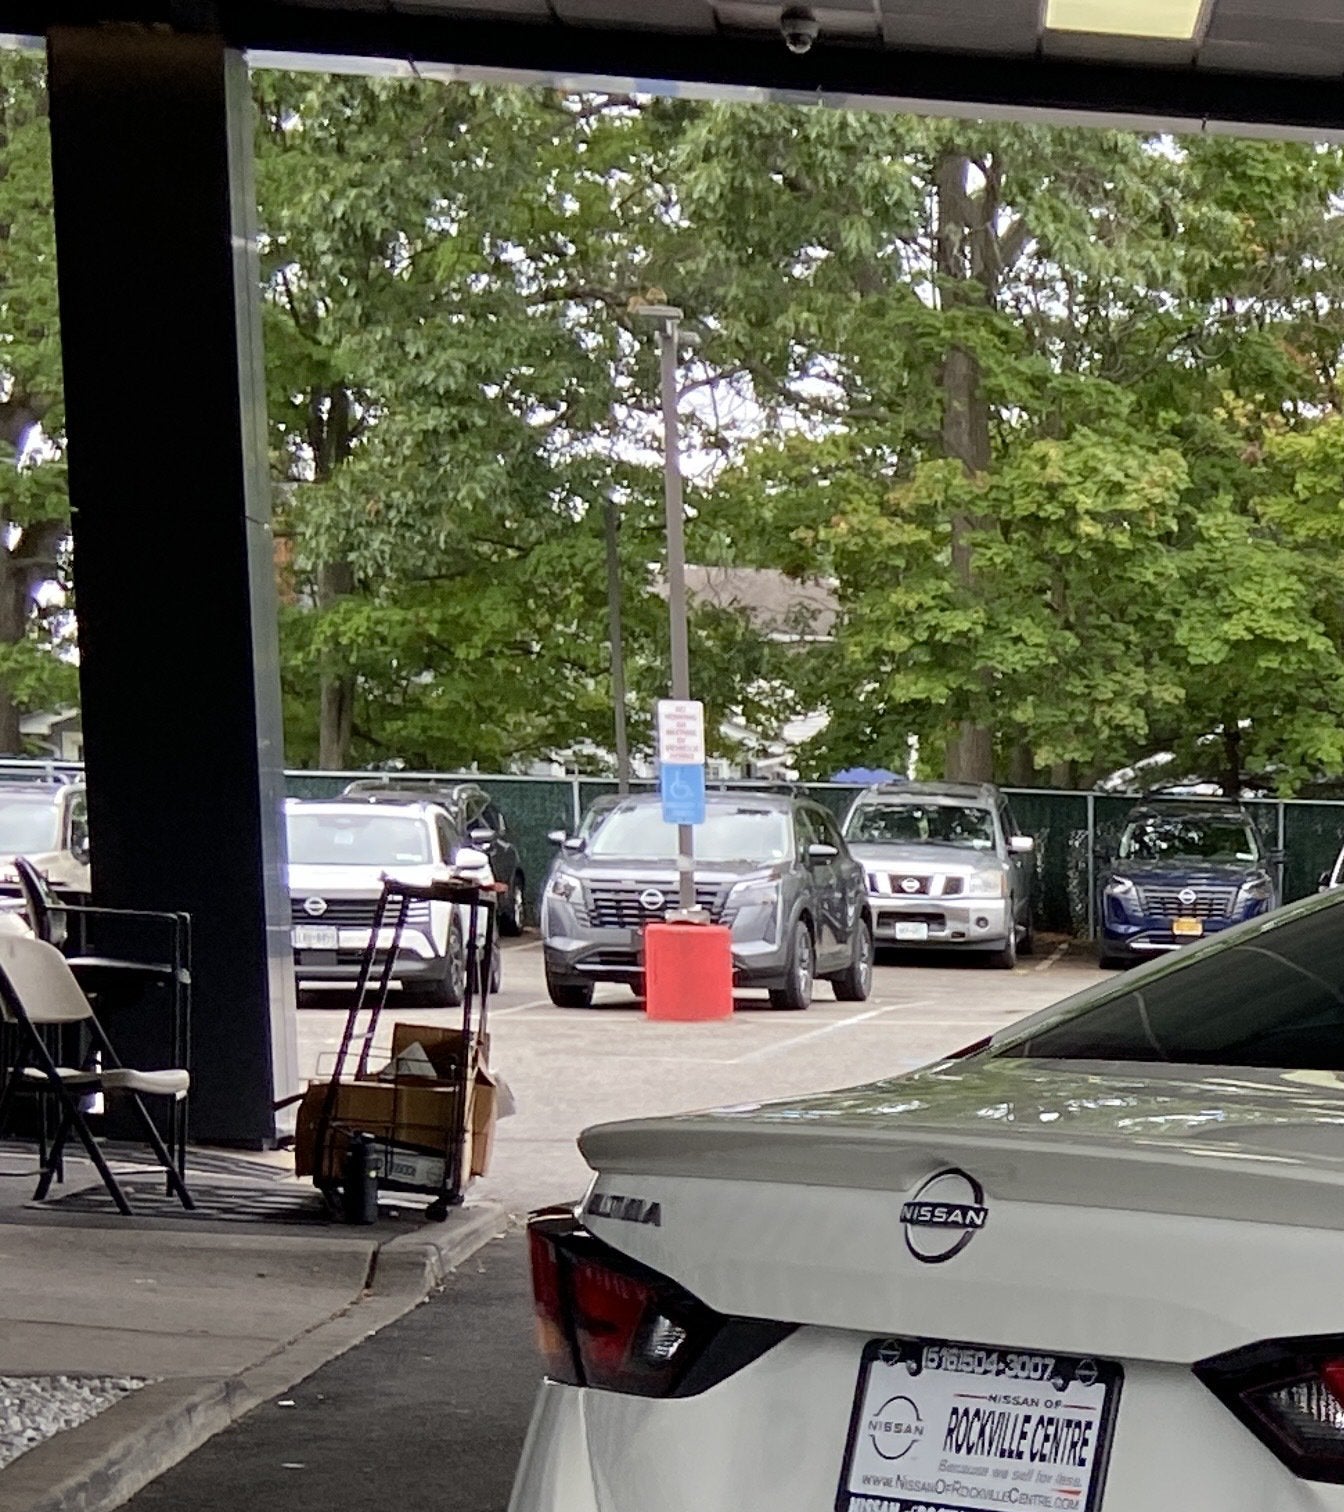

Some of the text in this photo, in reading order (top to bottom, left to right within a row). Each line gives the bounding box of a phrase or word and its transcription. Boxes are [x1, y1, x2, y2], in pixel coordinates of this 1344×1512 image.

[900, 1205, 985, 1225] NISSAN
[987, 1394, 1063, 1409] NISSAN OF
[868, 1419, 925, 1436] NISSAN
[943, 1406, 1093, 1467] ROCKVILLE CENTRE
